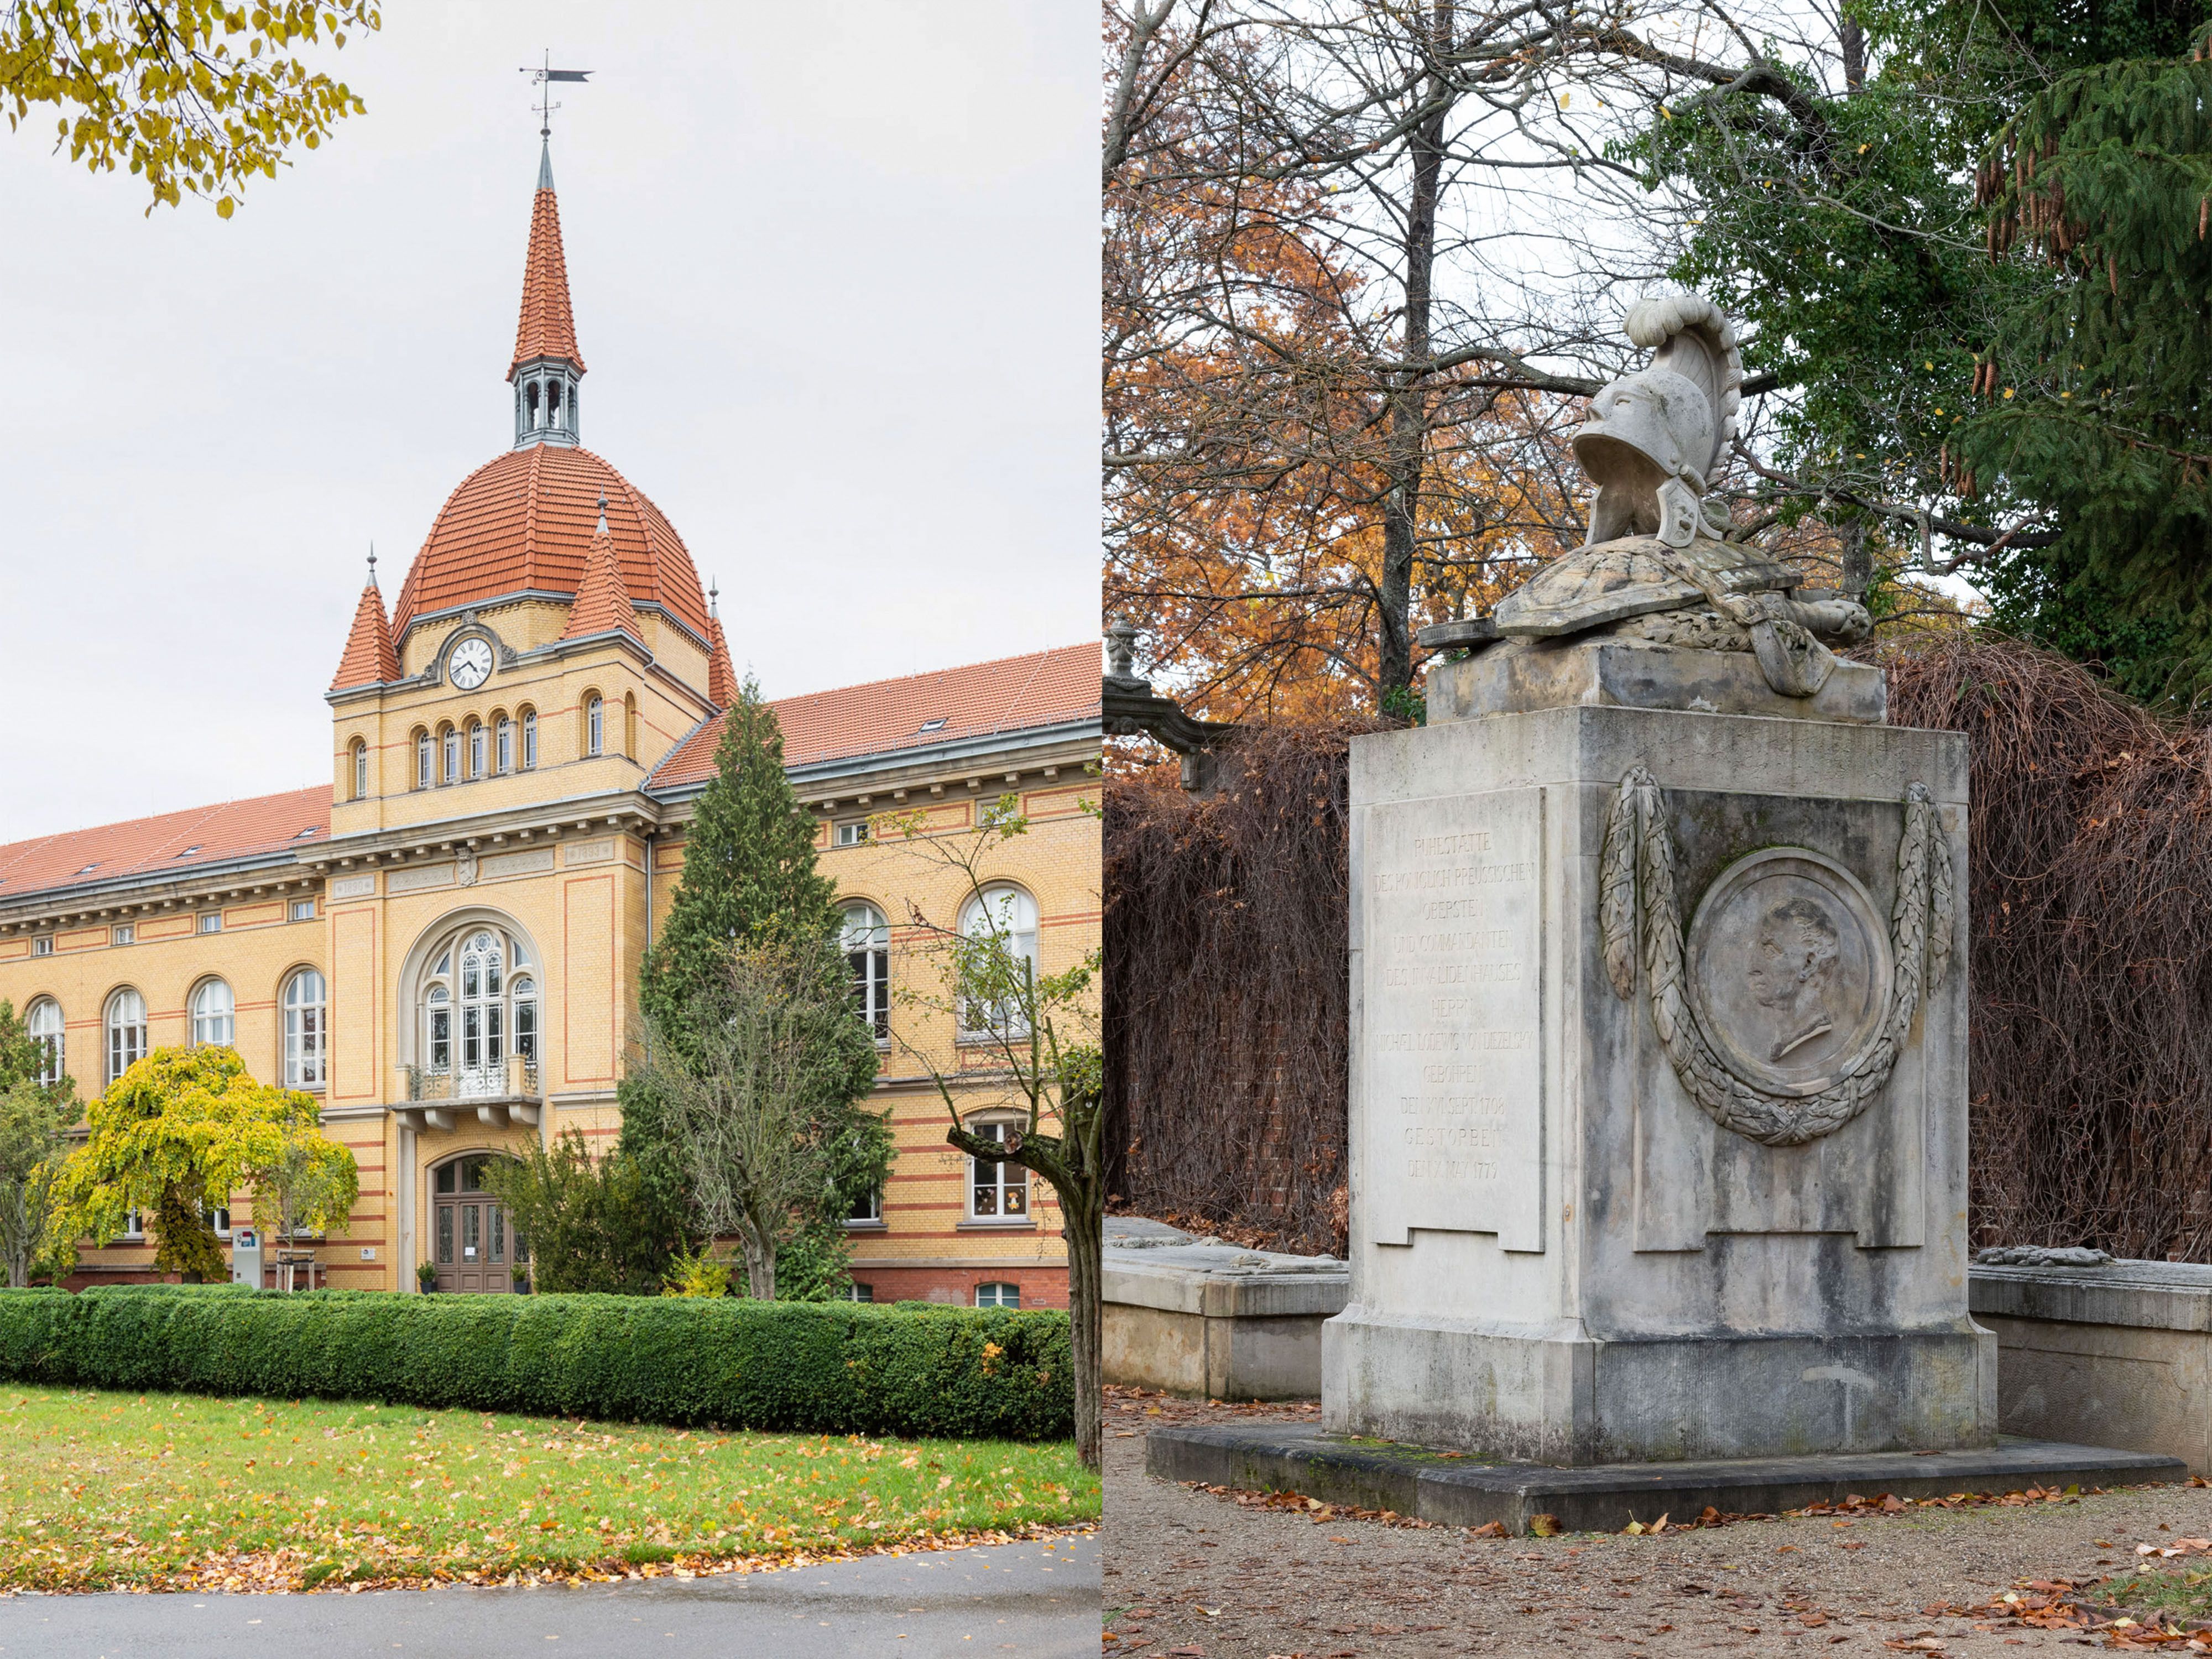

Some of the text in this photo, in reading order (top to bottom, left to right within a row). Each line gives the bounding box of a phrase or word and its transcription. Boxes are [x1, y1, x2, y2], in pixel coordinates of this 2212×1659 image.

[1374, 873, 1394, 893] DES
[1393, 936, 1416, 953] UND
[1386, 968, 1408, 986] DES
[1473, 1160, 1499, 1180] 1779
